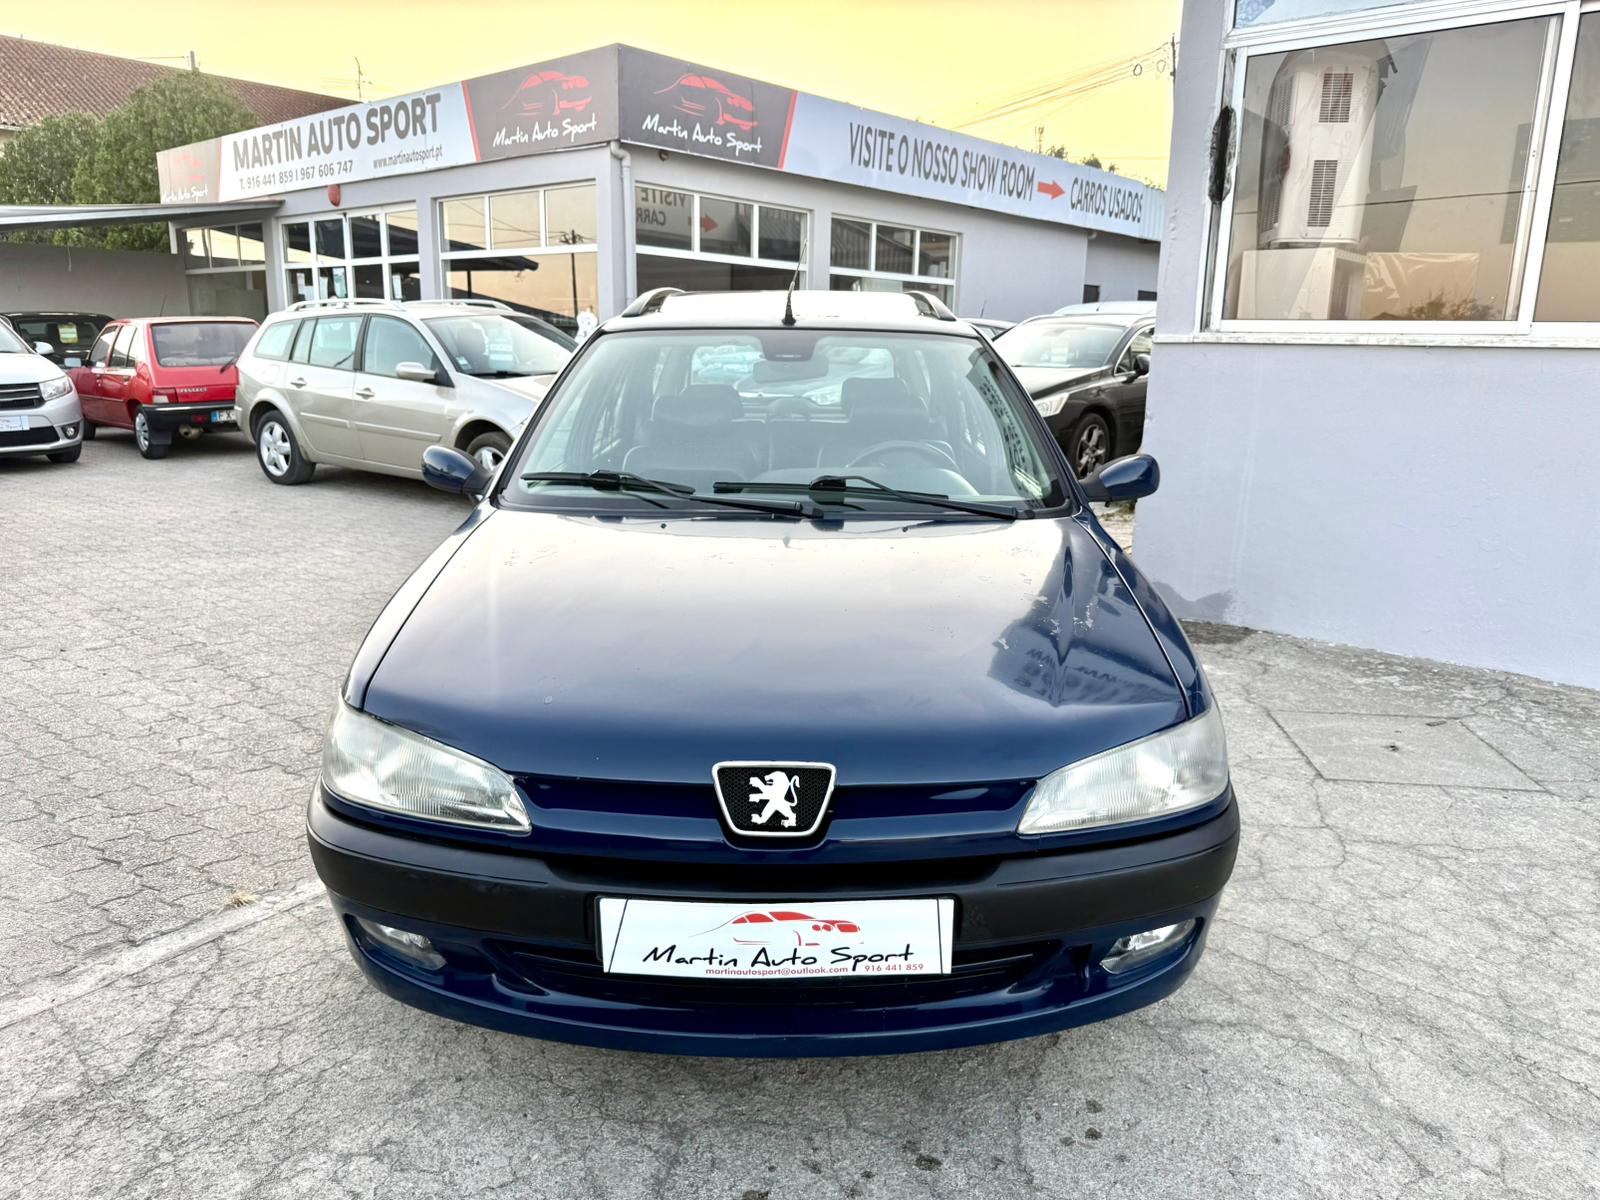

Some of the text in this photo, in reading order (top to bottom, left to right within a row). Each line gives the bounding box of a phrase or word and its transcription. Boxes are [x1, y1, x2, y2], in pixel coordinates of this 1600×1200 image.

[233, 93, 441, 172] MARTIN AUTO SPORT
[493, 111, 597, 148] Martin Auto Sport
[642, 113, 762, 156] Martin Auto Sport
[373, 144, 443, 169] www.martinautosport.pt
[850, 122, 1036, 201] VISITE O NOSSO SHOW ROOM
[247, 176, 261, 189] 916
[262, 174, 276, 186] 441
[279, 170, 294, 184] 859
[300, 166, 315, 181] 967
[318, 164, 335, 178] 606
[336, 159, 353, 175] 747
[1070, 177, 1143, 223] CARROS USADOS
[642, 943, 914, 972] Martin Auto Sport
[705, 966, 848, 976] martinautosport@outlook.com
[864, 963, 924, 973] 916 441 859
